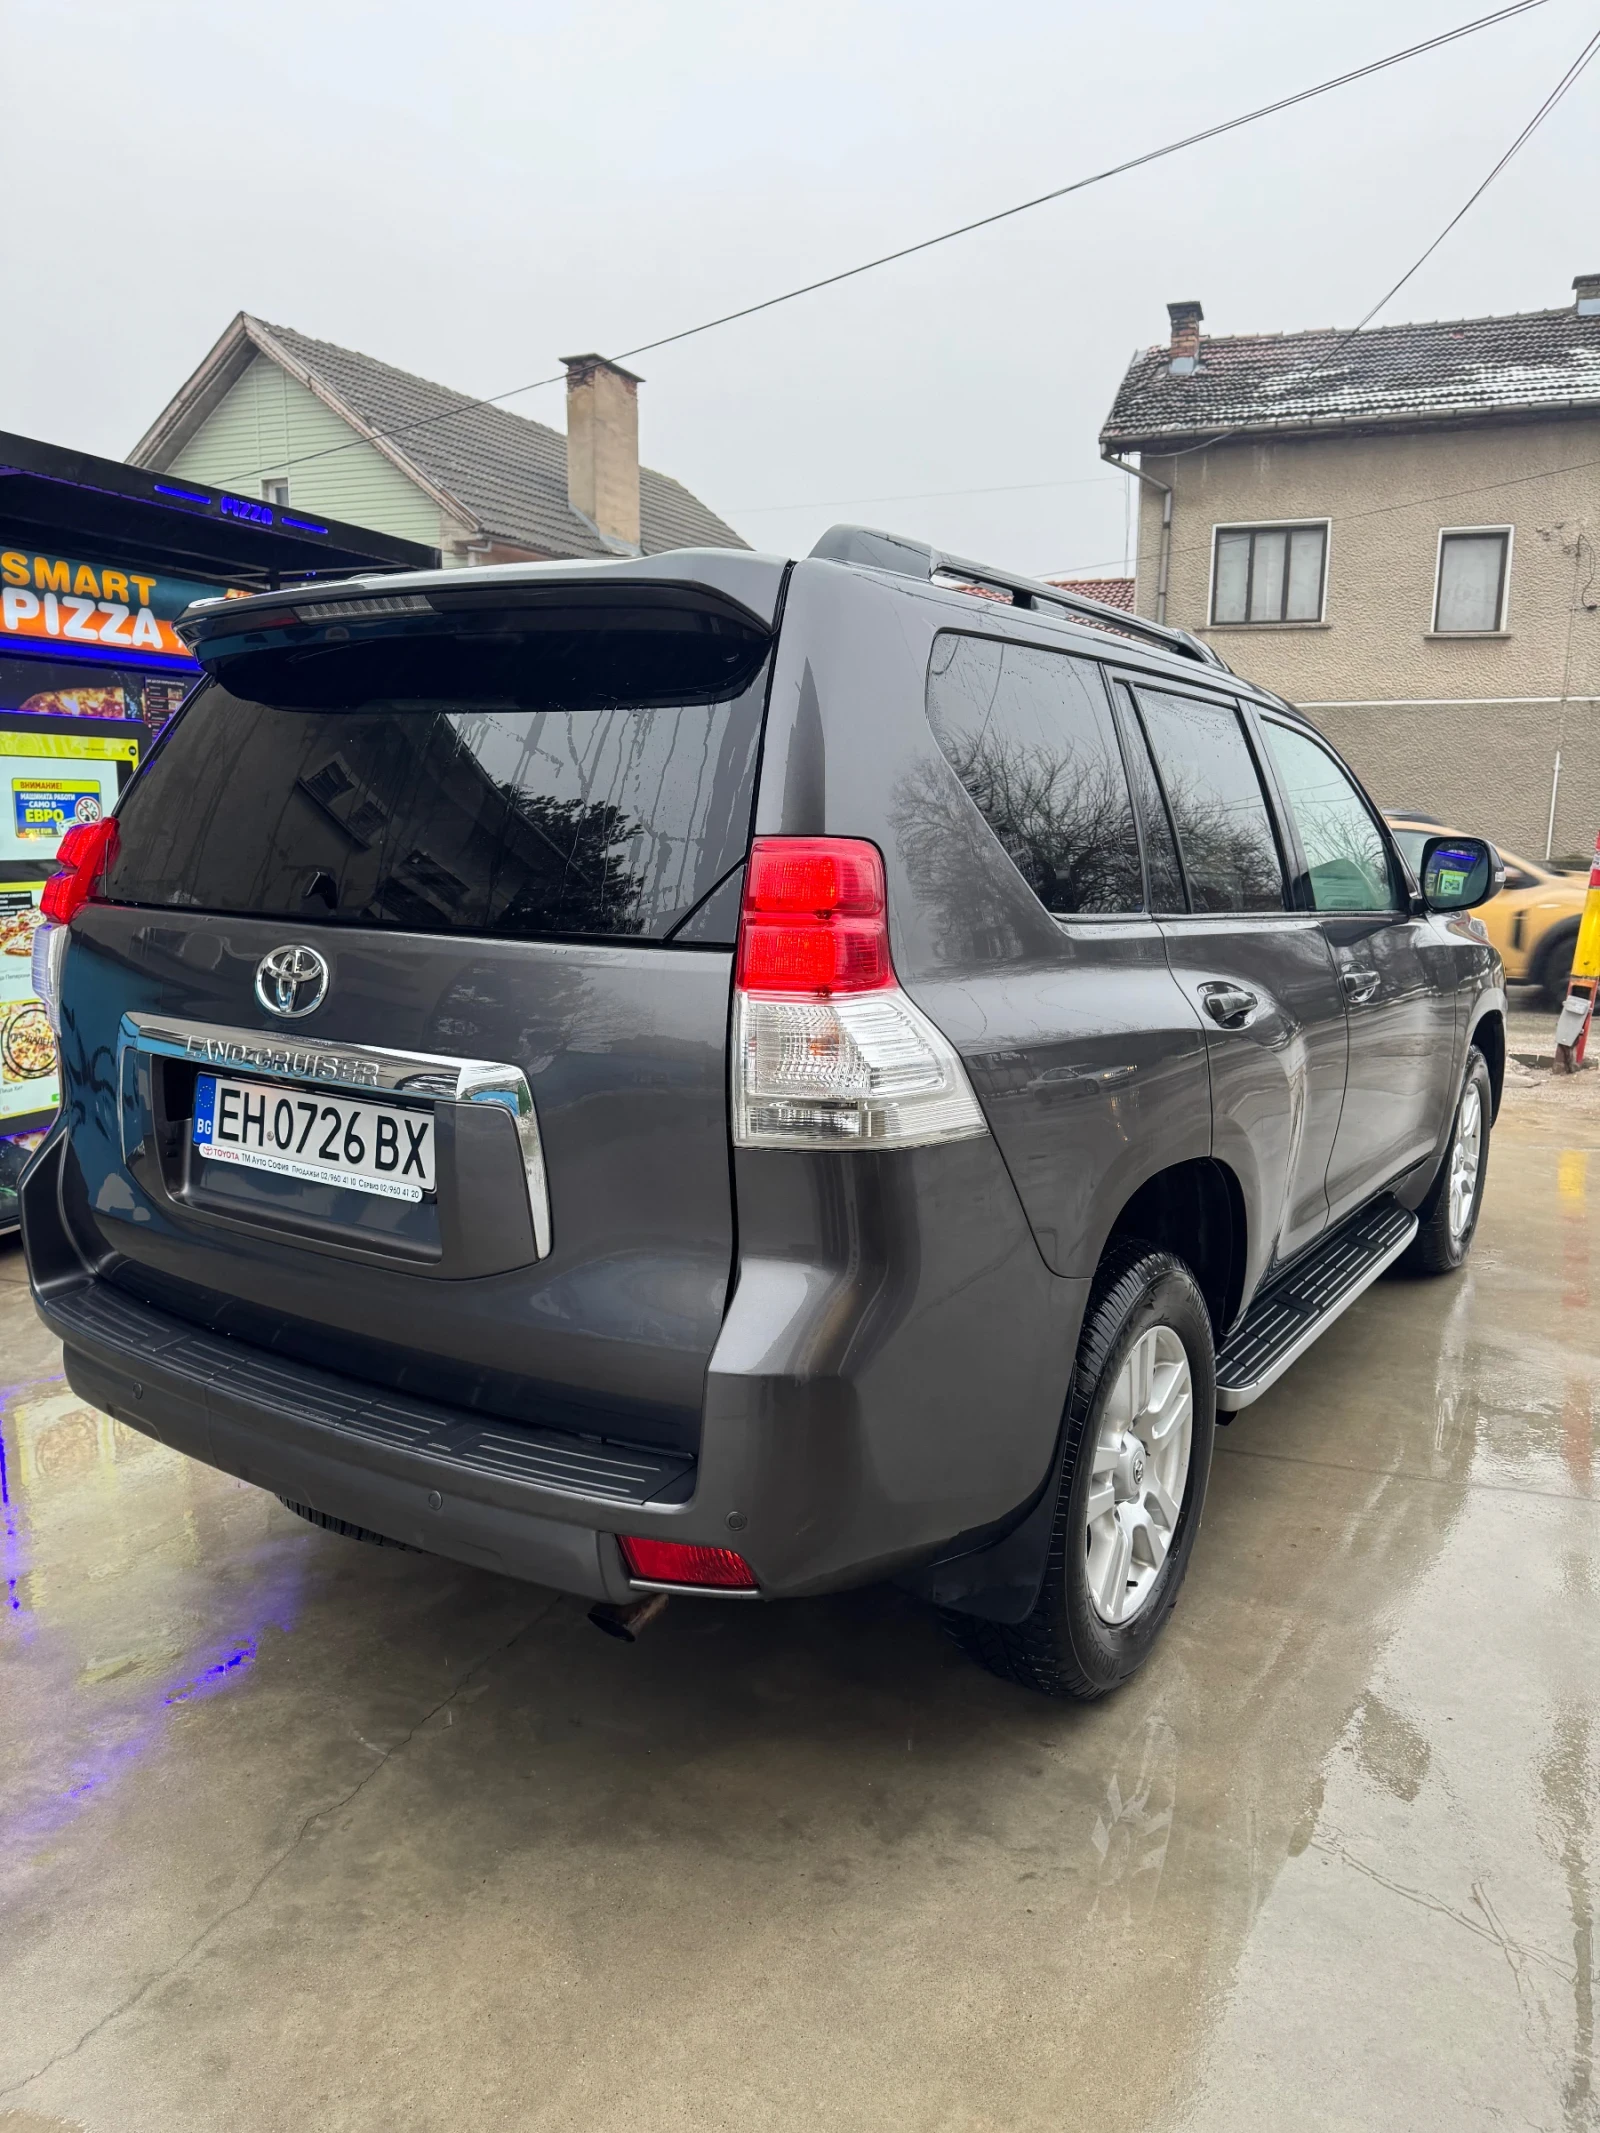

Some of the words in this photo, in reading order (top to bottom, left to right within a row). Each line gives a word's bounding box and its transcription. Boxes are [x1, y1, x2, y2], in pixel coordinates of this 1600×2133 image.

[221, 496, 274, 525] PIZZA
[1, 551, 157, 606] SMART
[2, 586, 163, 649] PIZZA
[20, 781, 63, 790] ВНИМАНИЕ!
[54, 793, 76, 801] РАБОТИ
[25, 808, 65, 823] ЕВРО
[184, 1035, 248, 1066] LAND
[254, 1048, 380, 1086] CRUISER
[197, 1118, 212, 1134] BG
[273, 1098, 366, 1164] 0726
[213, 1148, 239, 1161] TOYOTA
[411, 1190, 420, 1199] 20
